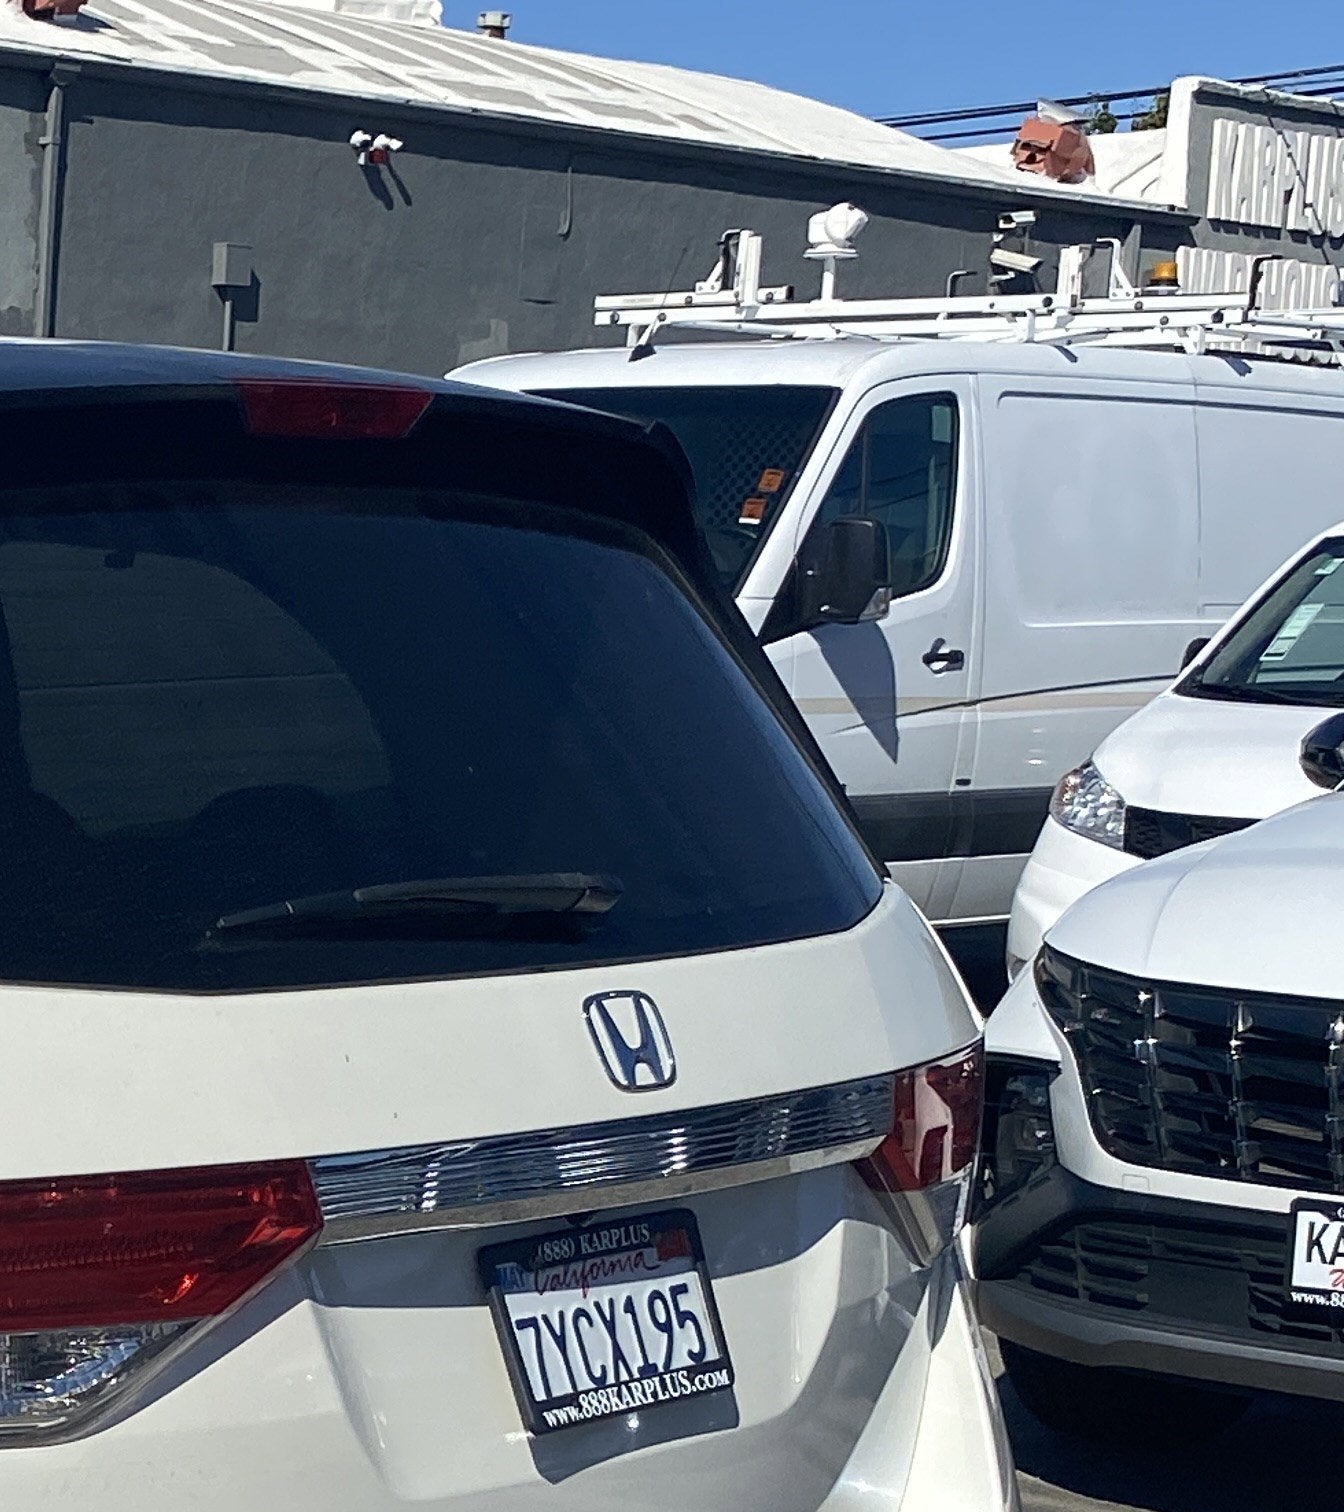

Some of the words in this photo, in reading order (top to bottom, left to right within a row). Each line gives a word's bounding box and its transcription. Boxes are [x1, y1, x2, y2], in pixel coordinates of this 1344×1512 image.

[537, 1238, 575, 1263] (888)
[579, 1223, 651, 1254] KARPLUS
[534, 1251, 660, 1299] California
[514, 1282, 707, 1402] 7YCX195
